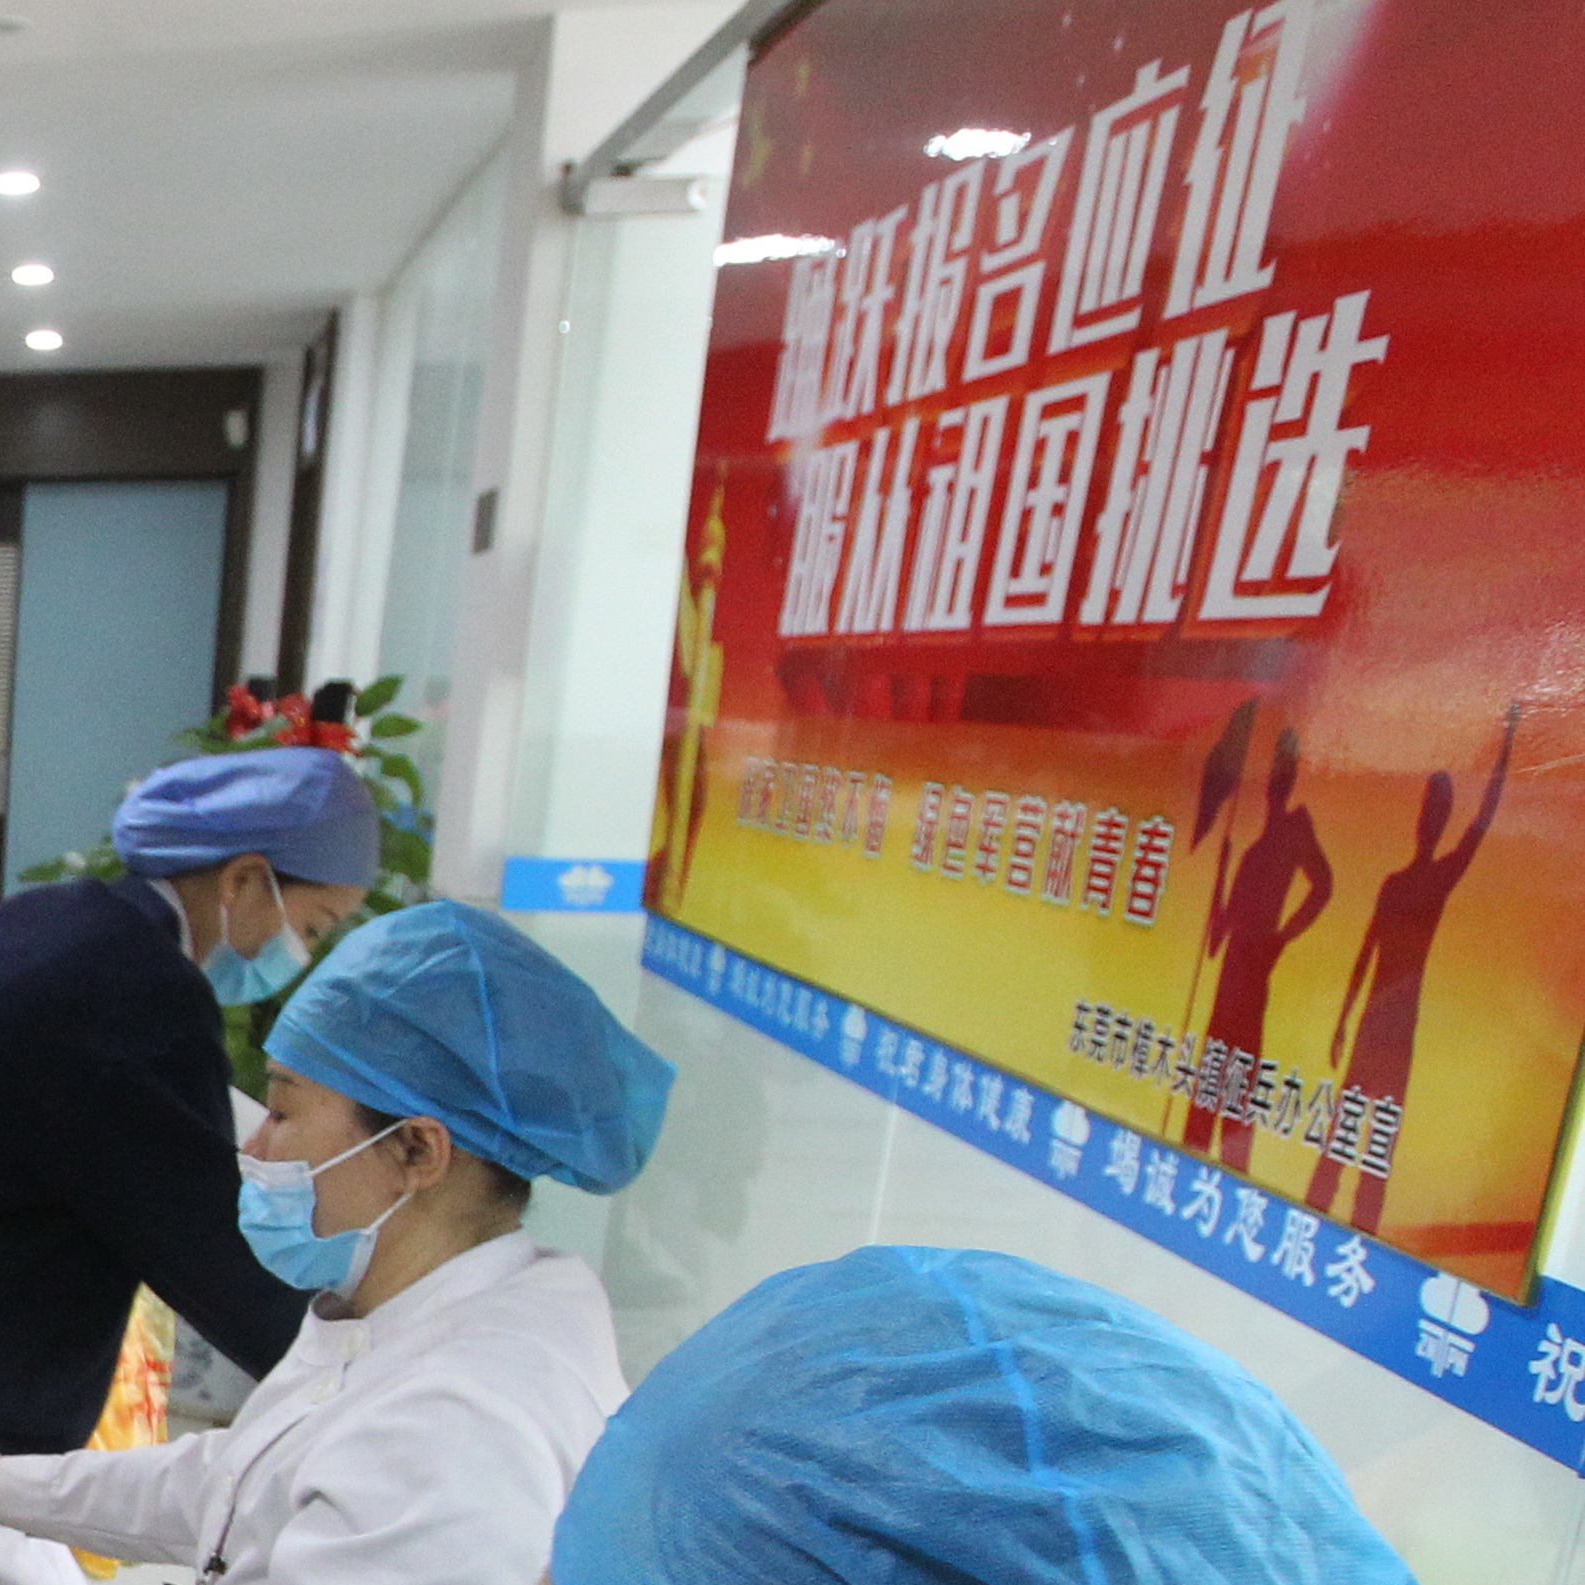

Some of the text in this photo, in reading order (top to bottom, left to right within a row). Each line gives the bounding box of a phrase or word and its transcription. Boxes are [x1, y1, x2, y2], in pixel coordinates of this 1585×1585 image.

[778, 290, 1389, 637] 服从祖国挑选
[911, 779, 1175, 926] 绿色军营献青春
[1068, 998, 1402, 1179] 东莞市樟木头镇征兵办公室宣
[1104, 1128, 1377, 1307] 竭诚为您服务
